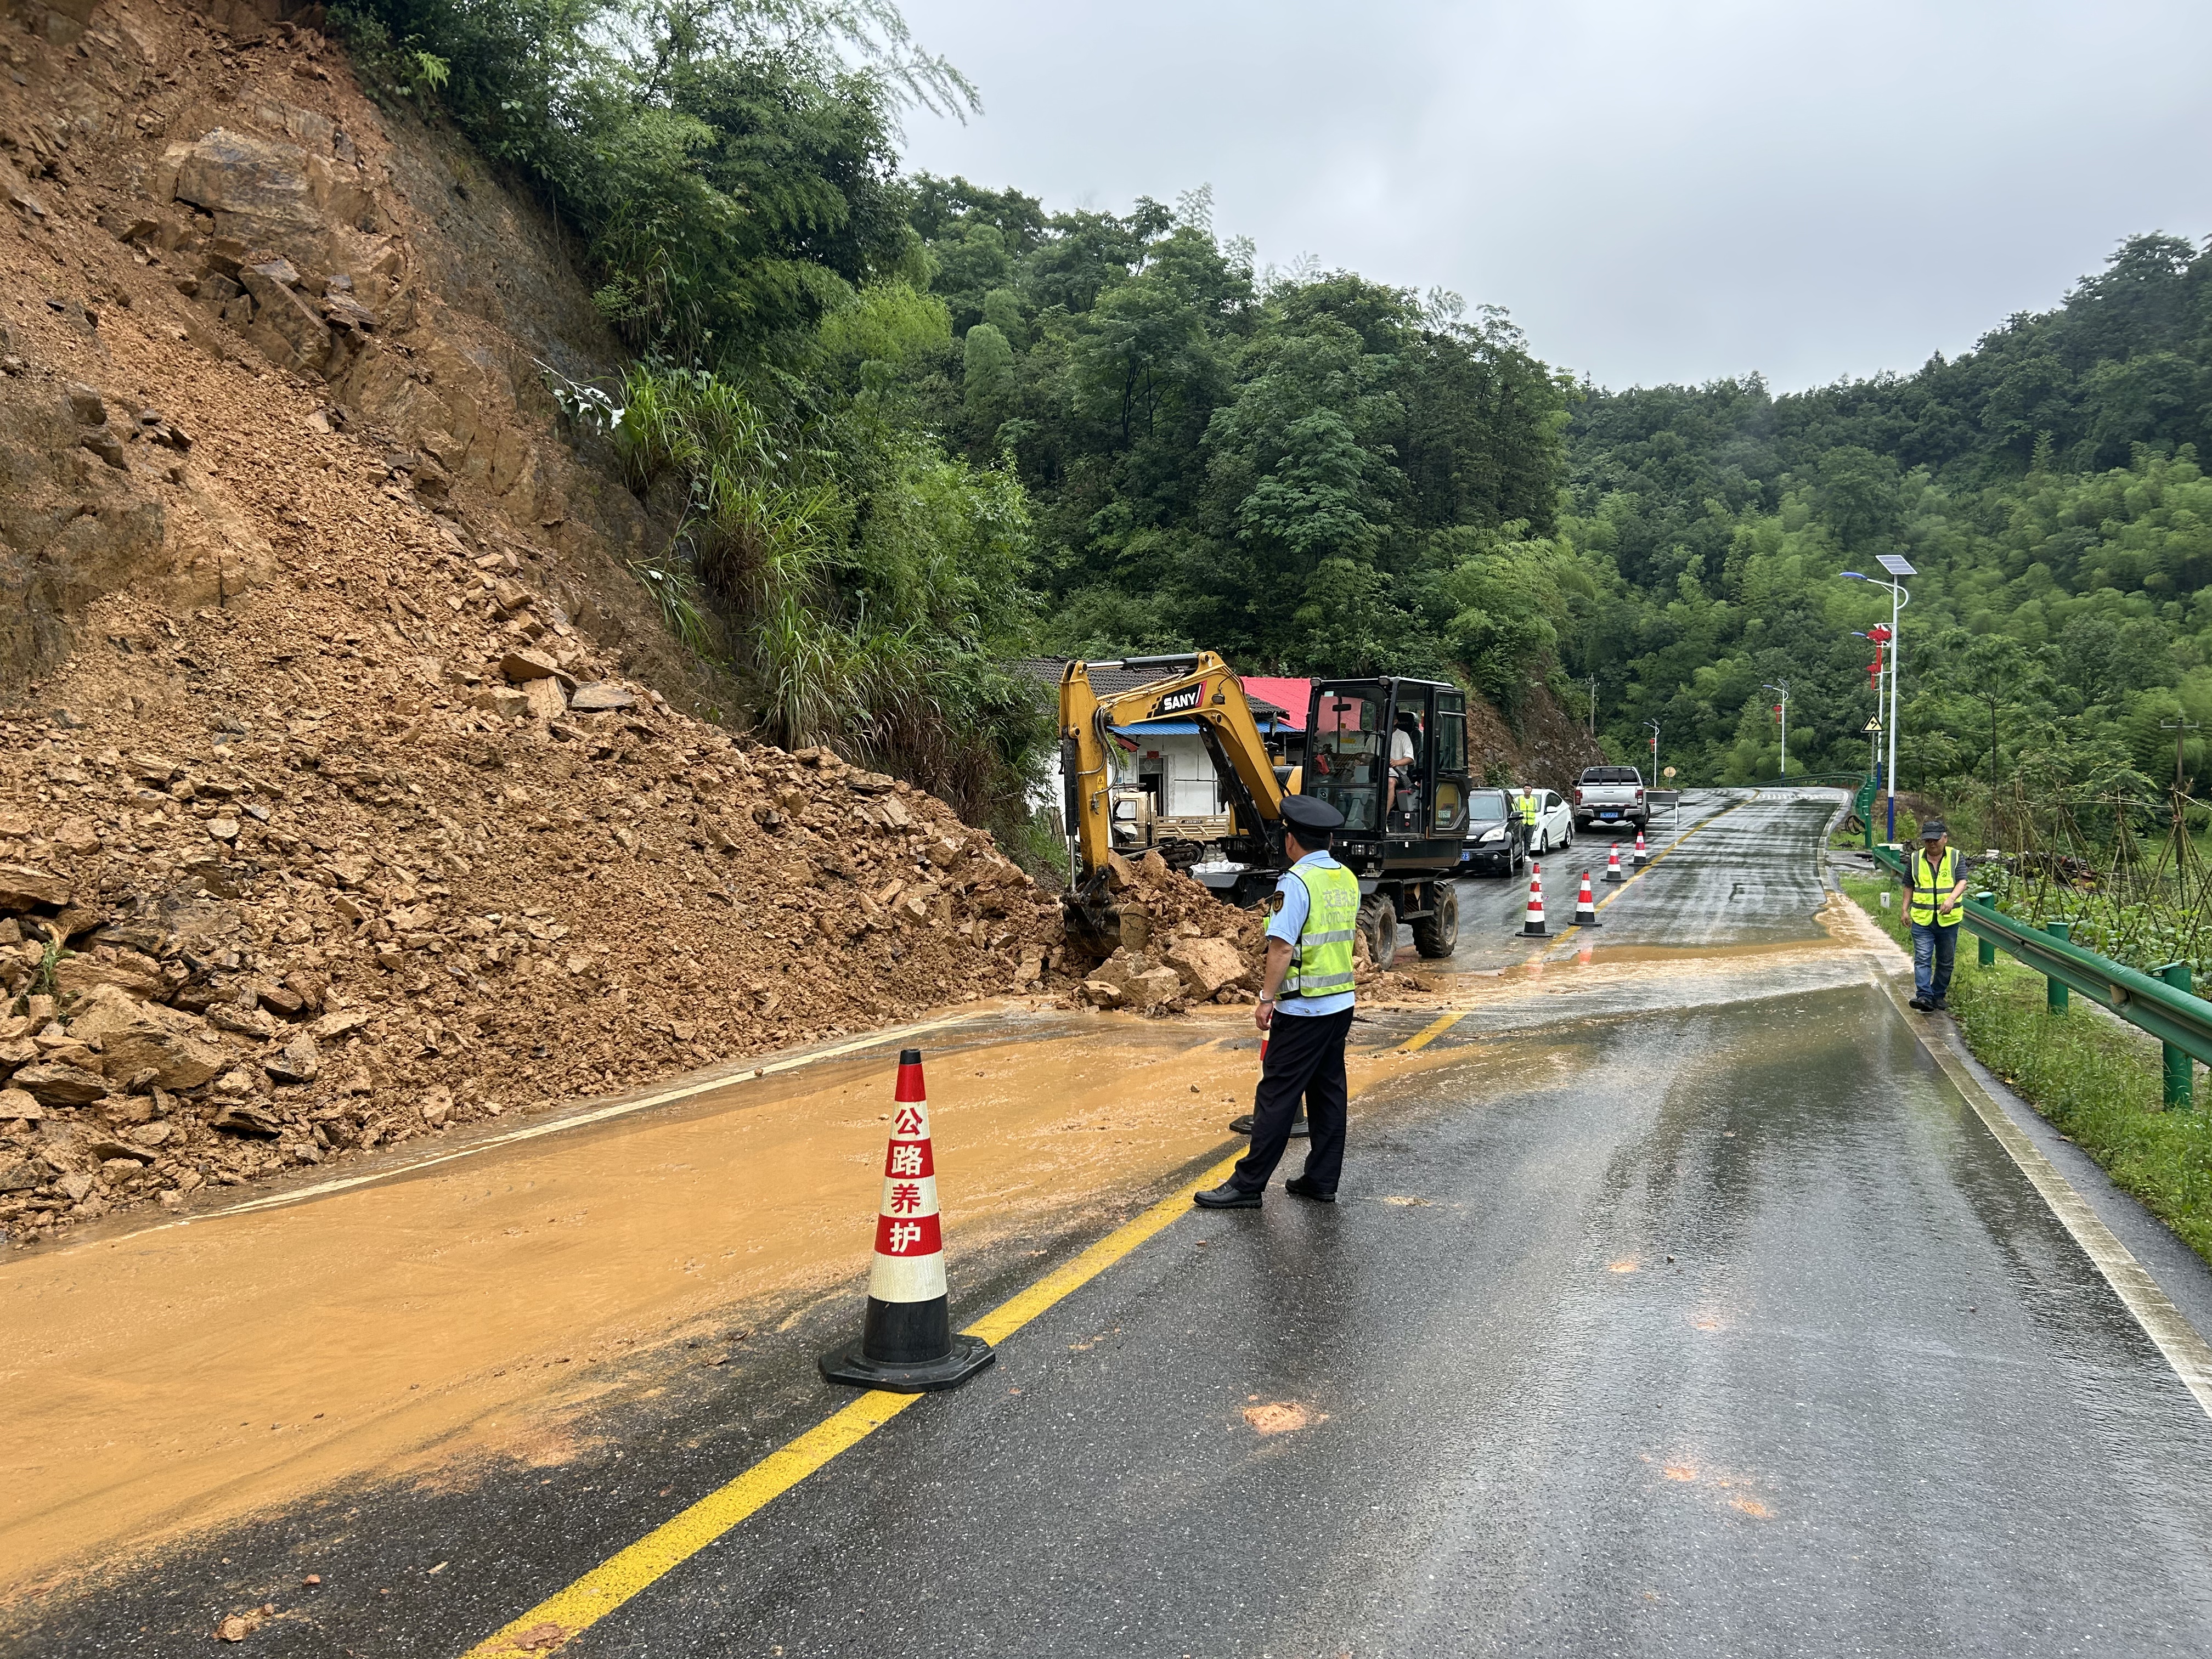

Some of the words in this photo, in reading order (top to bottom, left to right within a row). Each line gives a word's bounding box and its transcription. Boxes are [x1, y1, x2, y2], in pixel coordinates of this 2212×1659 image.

[1164, 692, 1196, 710] SANY
[1322, 888, 1356, 909] 交通执法
[890, 1107, 923, 1253] 公路养护
